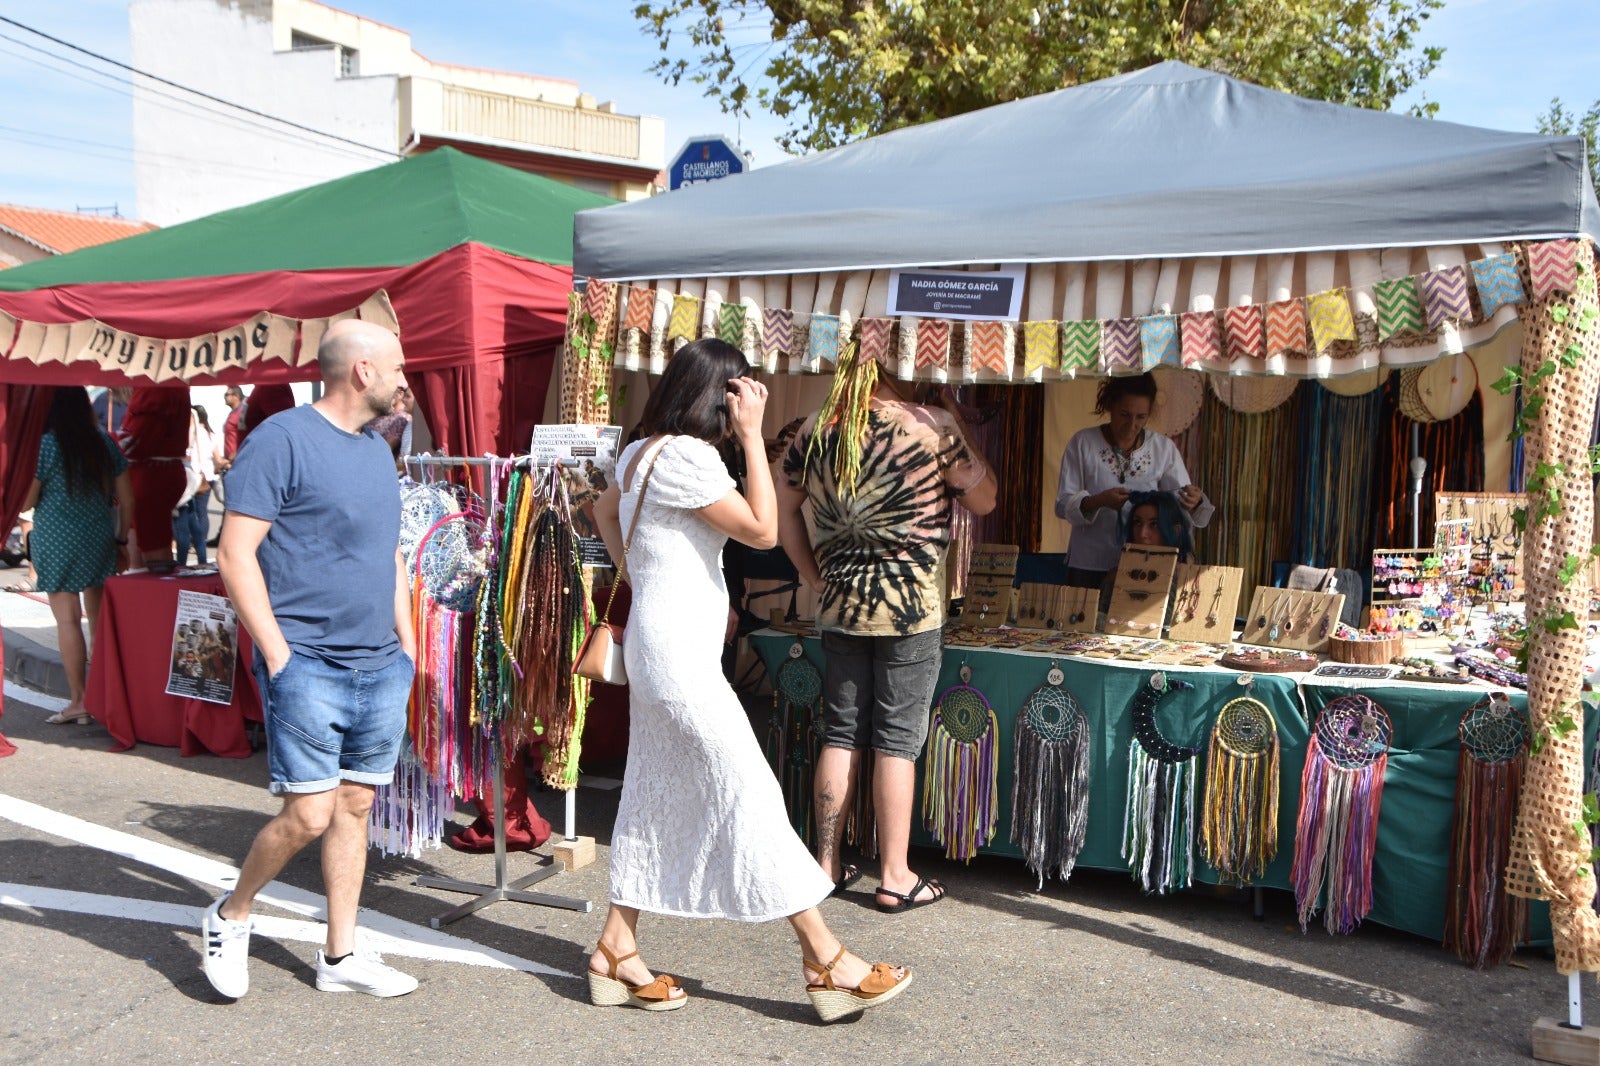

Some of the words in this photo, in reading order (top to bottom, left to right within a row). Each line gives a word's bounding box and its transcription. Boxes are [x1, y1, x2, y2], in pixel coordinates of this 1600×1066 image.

[683, 160, 729, 171] CASTELLANOS
[693, 167, 729, 178] MORISCOS
[911, 280, 937, 289] NADIA
[938, 279, 967, 290] GÓMEZ
[968, 281, 999, 292] GARCÍA
